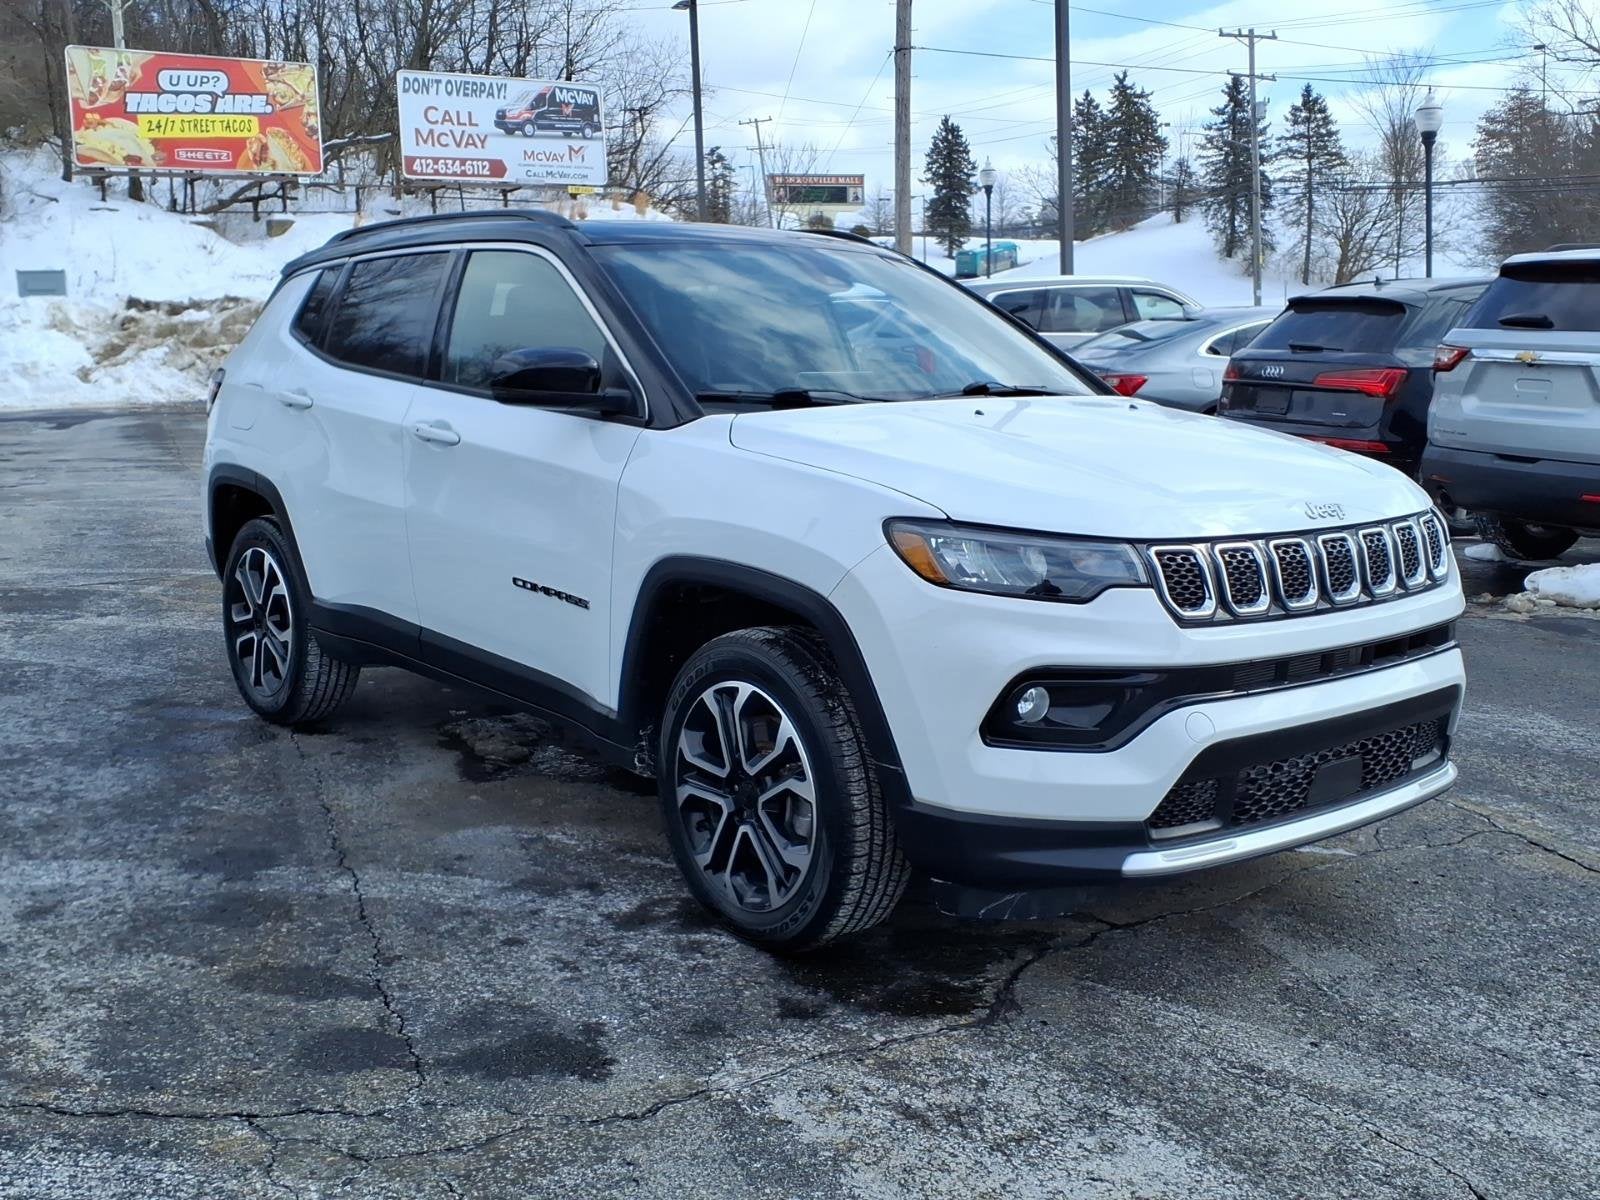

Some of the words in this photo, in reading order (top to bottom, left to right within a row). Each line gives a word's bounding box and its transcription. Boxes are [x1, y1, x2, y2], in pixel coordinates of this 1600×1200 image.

[168, 75, 180, 86] U
[188, 75, 221, 88] UP?
[402, 77, 444, 96] DON'T
[445, 79, 507, 100] OVERPAY!
[124, 92, 212, 113] TACOS
[214, 94, 272, 114] ARE.
[423, 105, 479, 127] CALL
[147, 118, 175, 135] 24/7
[179, 118, 218, 134] STREET
[220, 118, 252, 134] TACOS
[178, 150, 230, 161] SHEETZ
[413, 158, 490, 176] 412-634-6112
[838, 175, 860, 184] MALL
[1304, 502, 1345, 521] Jeep
[512, 576, 591, 610] COMPASS
